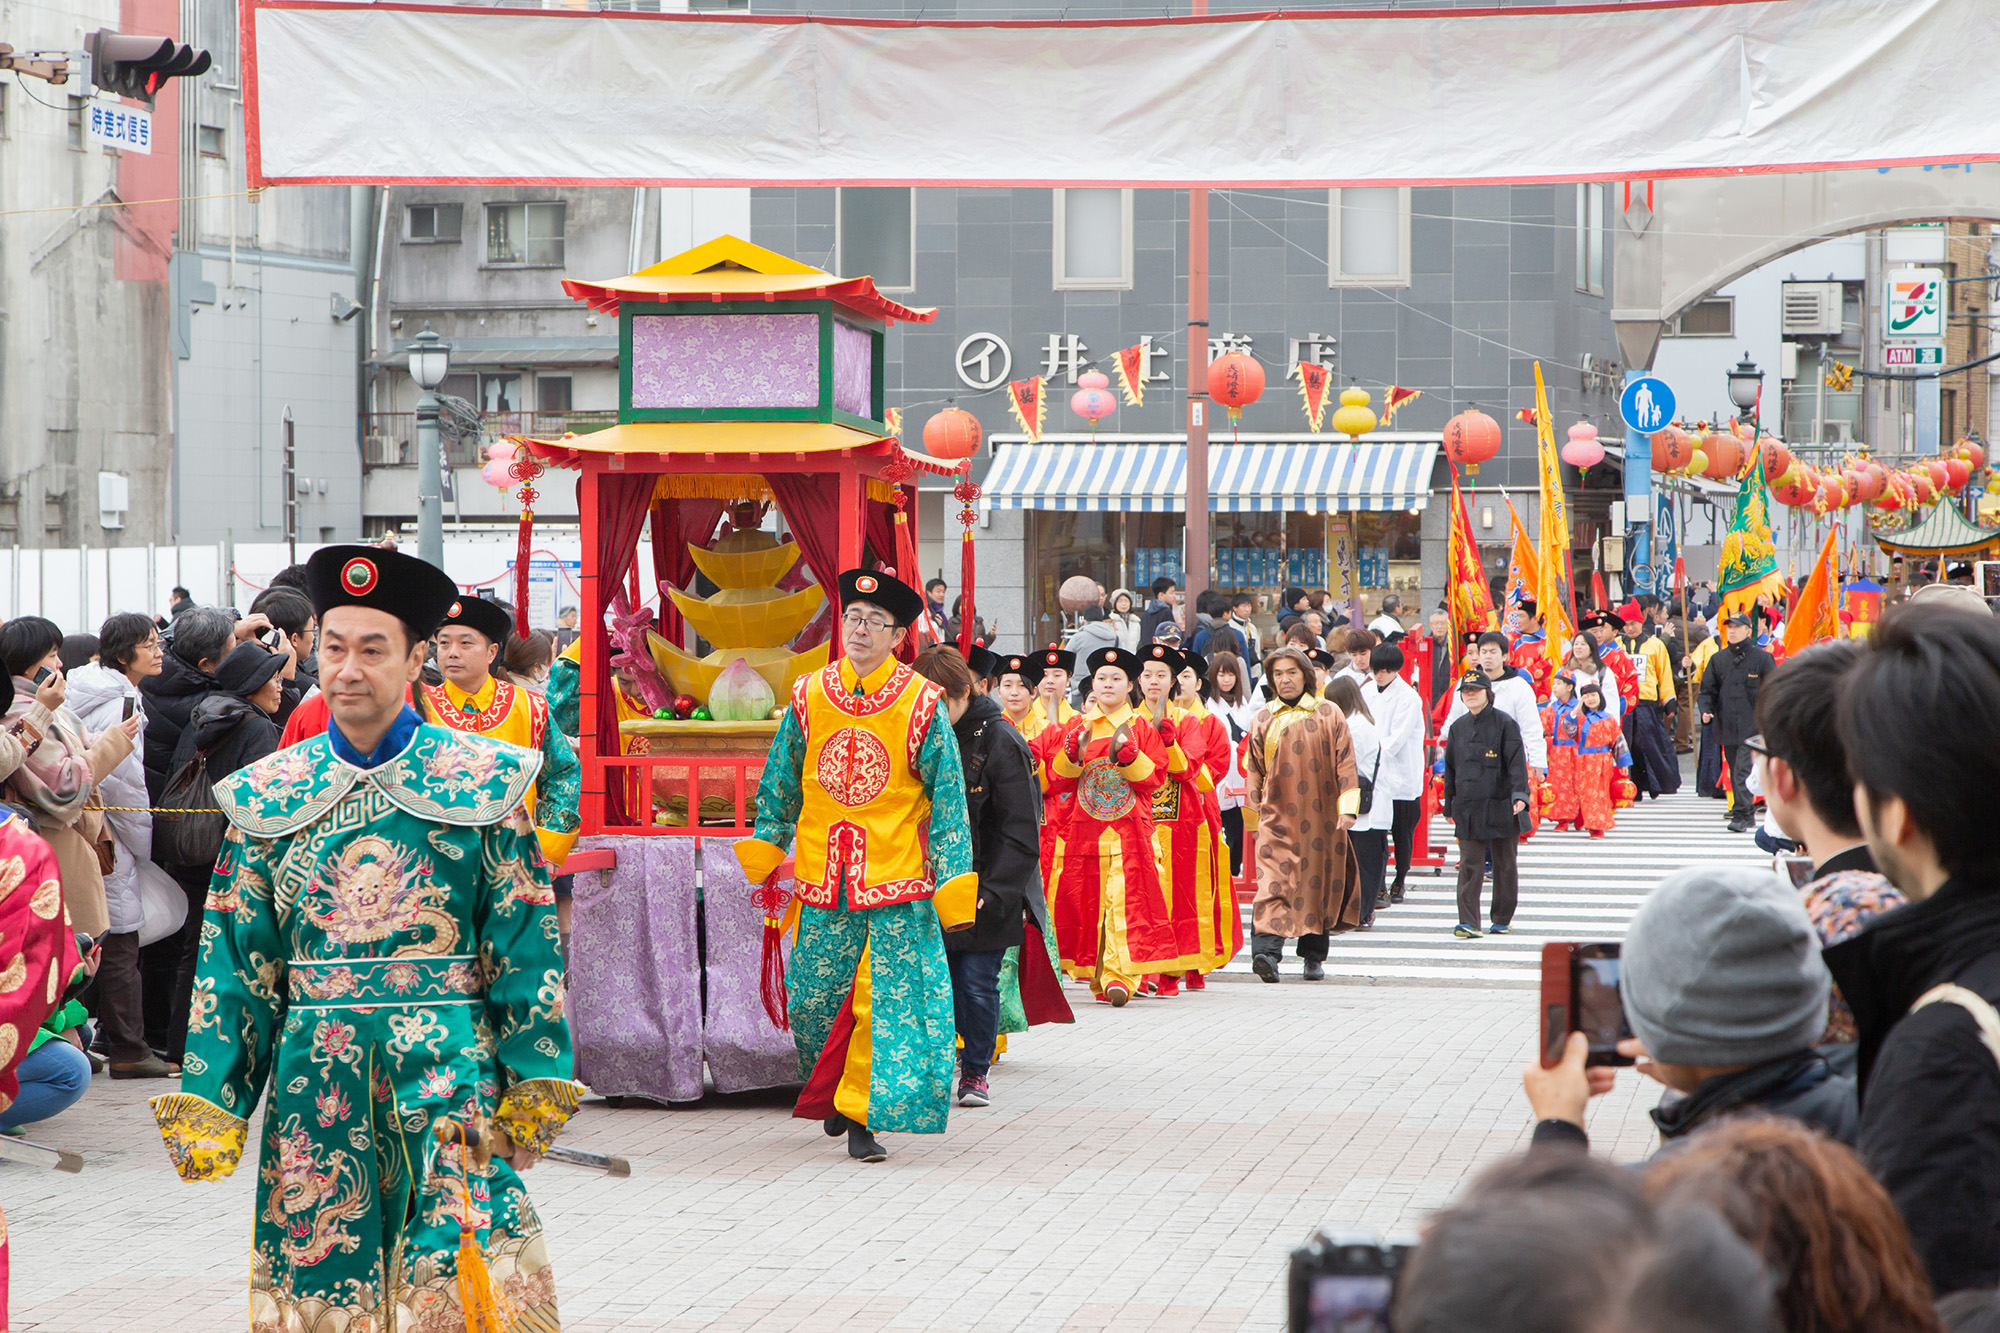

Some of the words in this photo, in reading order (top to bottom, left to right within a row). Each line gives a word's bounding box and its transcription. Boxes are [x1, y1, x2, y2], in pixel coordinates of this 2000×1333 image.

[91, 106, 149, 146] 時差式信号
[1889, 350, 1912, 363] ATM
[1922, 349, 1936, 363] 酒
